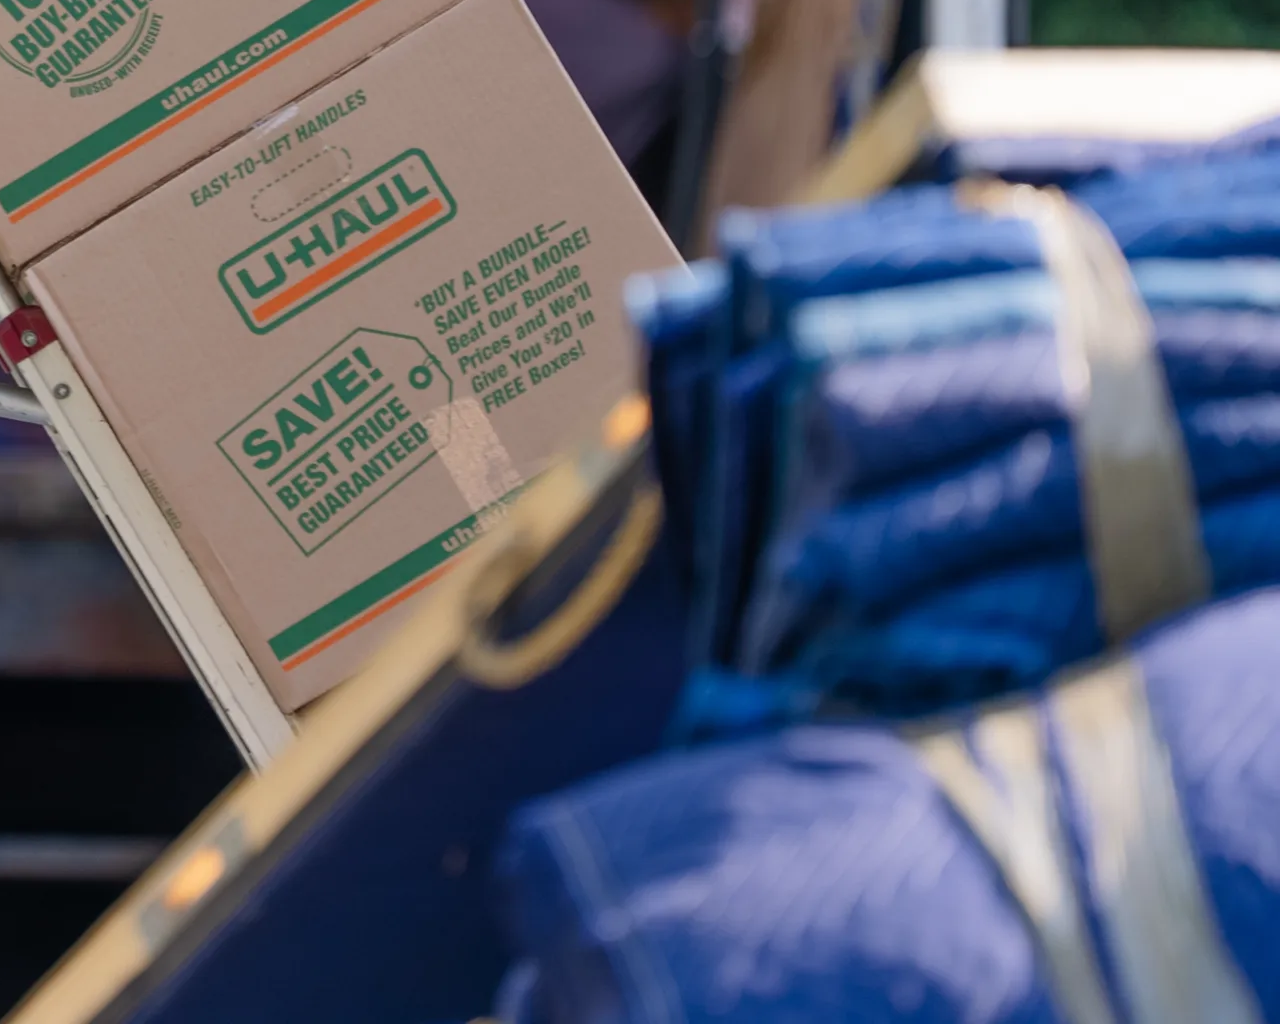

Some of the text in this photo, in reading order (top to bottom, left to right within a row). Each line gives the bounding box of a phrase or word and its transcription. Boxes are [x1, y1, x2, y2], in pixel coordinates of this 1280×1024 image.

[160, 29, 288, 110] uhaul.com
[190, 89, 367, 207] EASY-TO-LIFT HANDLES
[236, 173, 431, 300] U-HAUL
[433, 226, 592, 335] SAVE EVEN MORE!
[462, 270, 477, 291] A
[446, 264, 581, 355] Beat Our Bundle
[458, 281, 593, 375] Prices and We'll
[471, 309, 596, 394] Give You $20 in
[242, 346, 384, 470] SAVE!
[482, 339, 587, 414] FREE Boxes!
[275, 396, 412, 511] BEST PRICE
[297, 421, 429, 534] GUARANTEED
